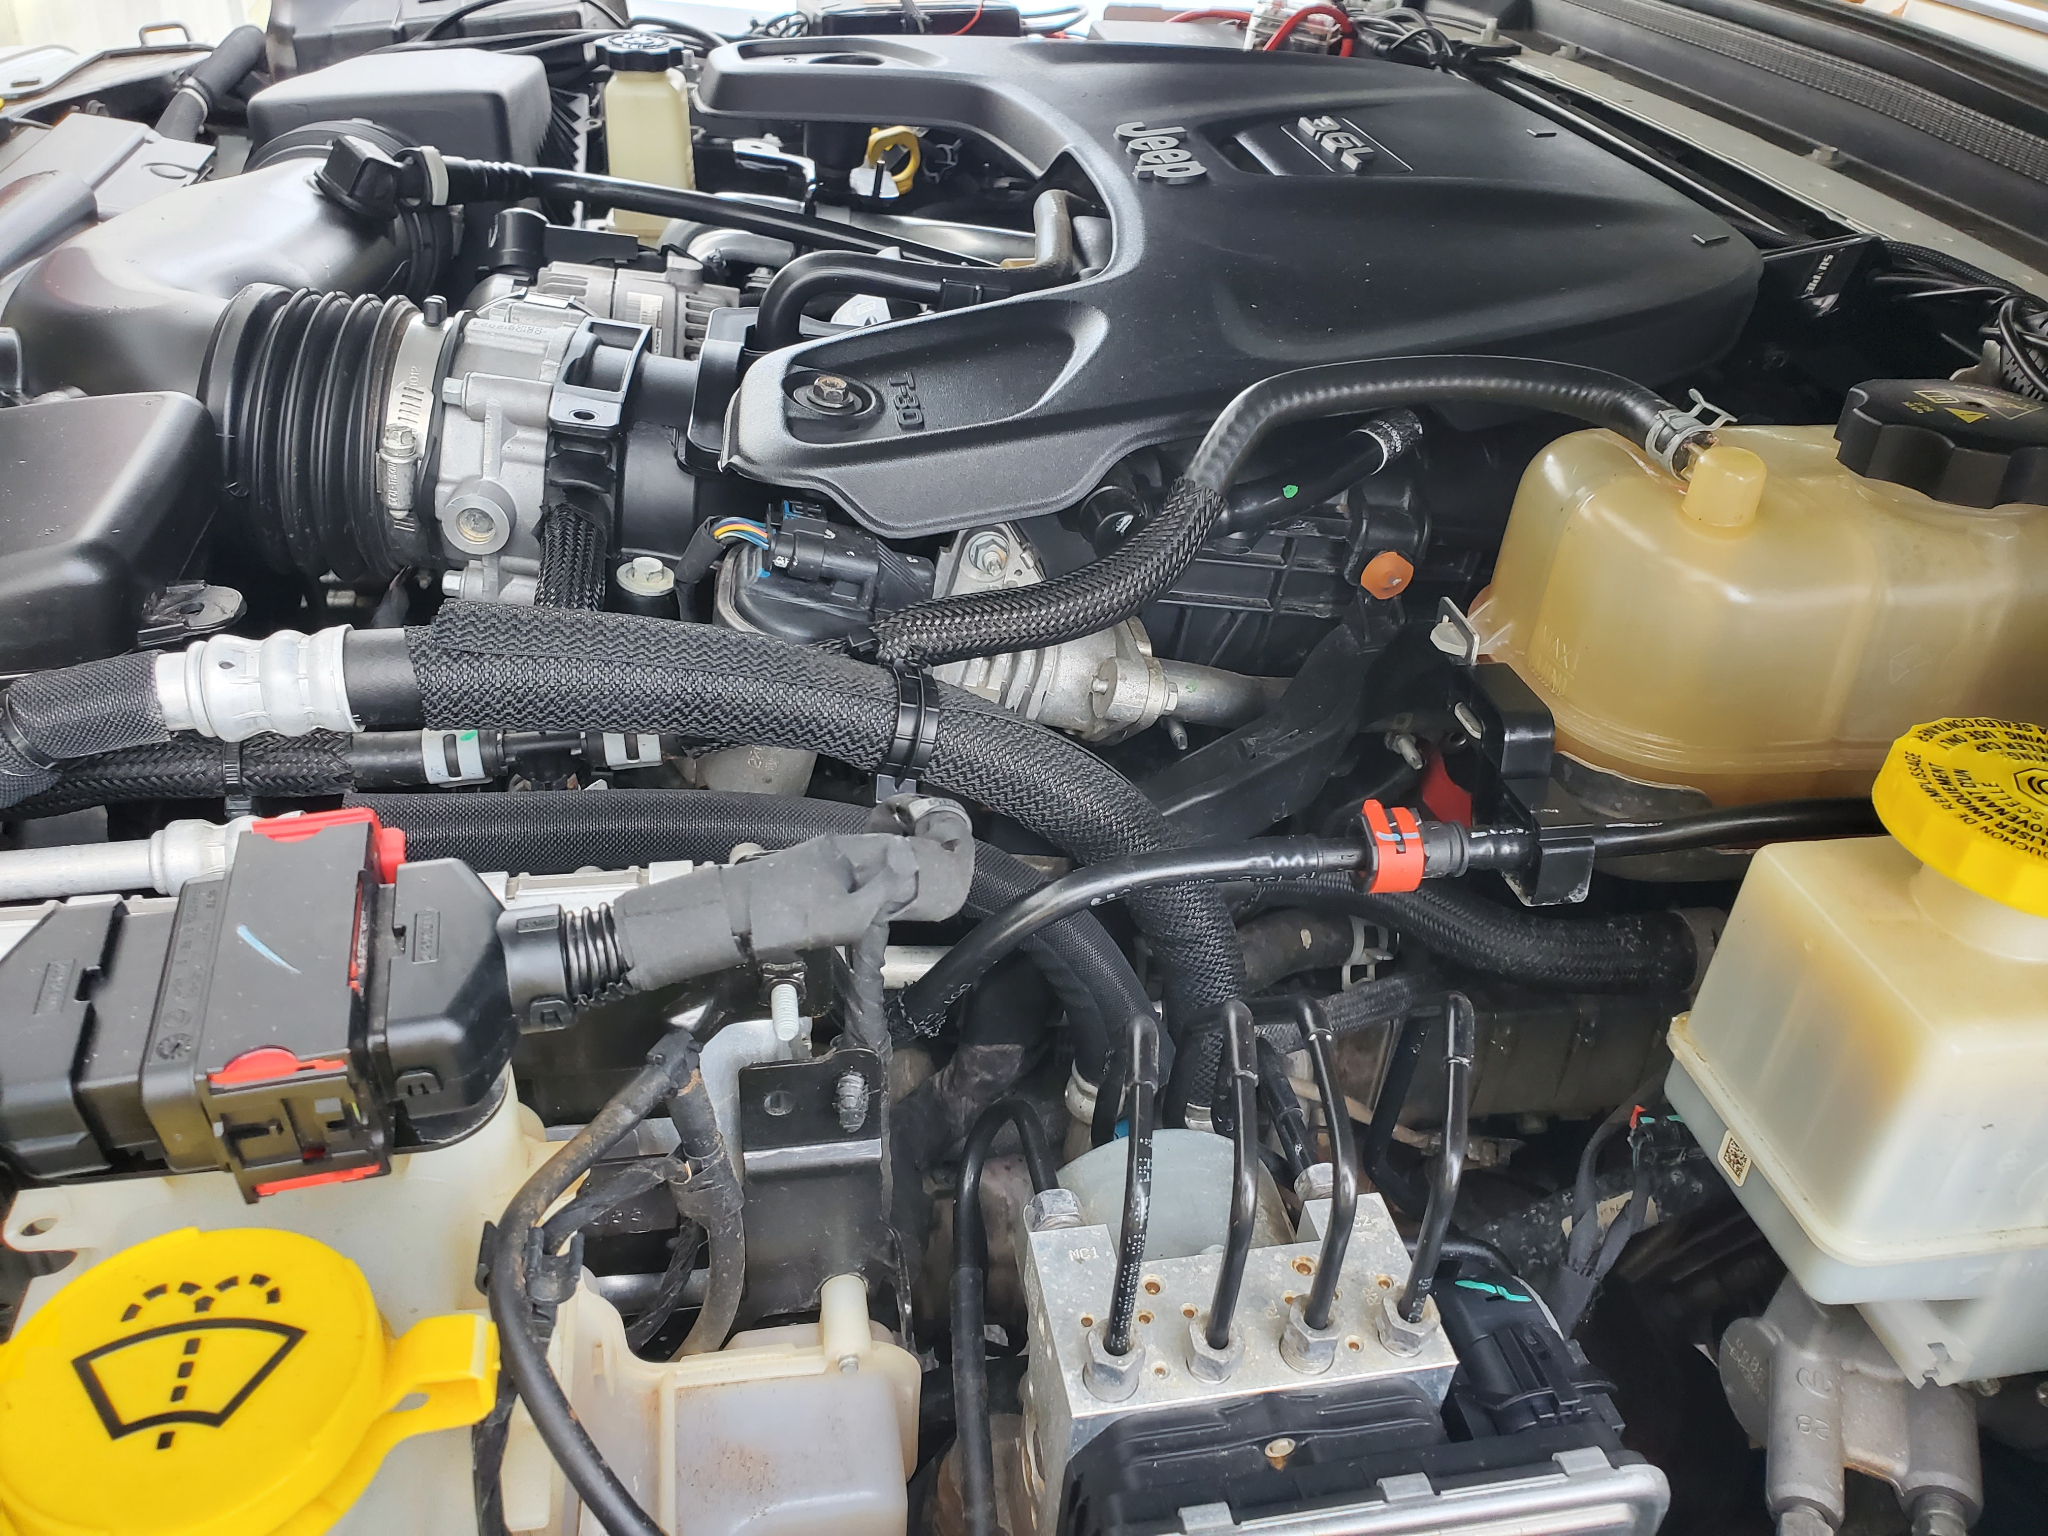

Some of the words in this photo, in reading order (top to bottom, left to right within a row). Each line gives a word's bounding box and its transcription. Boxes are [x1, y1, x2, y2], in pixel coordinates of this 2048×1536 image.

[1113, 121, 1207, 184] Jeep
[888, 370, 925, 431] T-30
[1964, 730, 1998, 740] USE
[1974, 719, 2034, 732] SEALED
[1937, 733, 1968, 751] ONLY
[1974, 741, 2002, 752] CAP
[2000, 741, 2048, 753] LLER
[1904, 750, 1957, 810] REMPLISSAGE
[1928, 761, 1994, 821] UNIQUEMENT
[1980, 780, 2044, 820] SCELLE
[1966, 790, 2048, 836] OVENANT
[1995, 821, 2048, 848] LISER
[1353, 1214, 1372, 1228] C2
[1068, 1246, 1100, 1262] MC1
